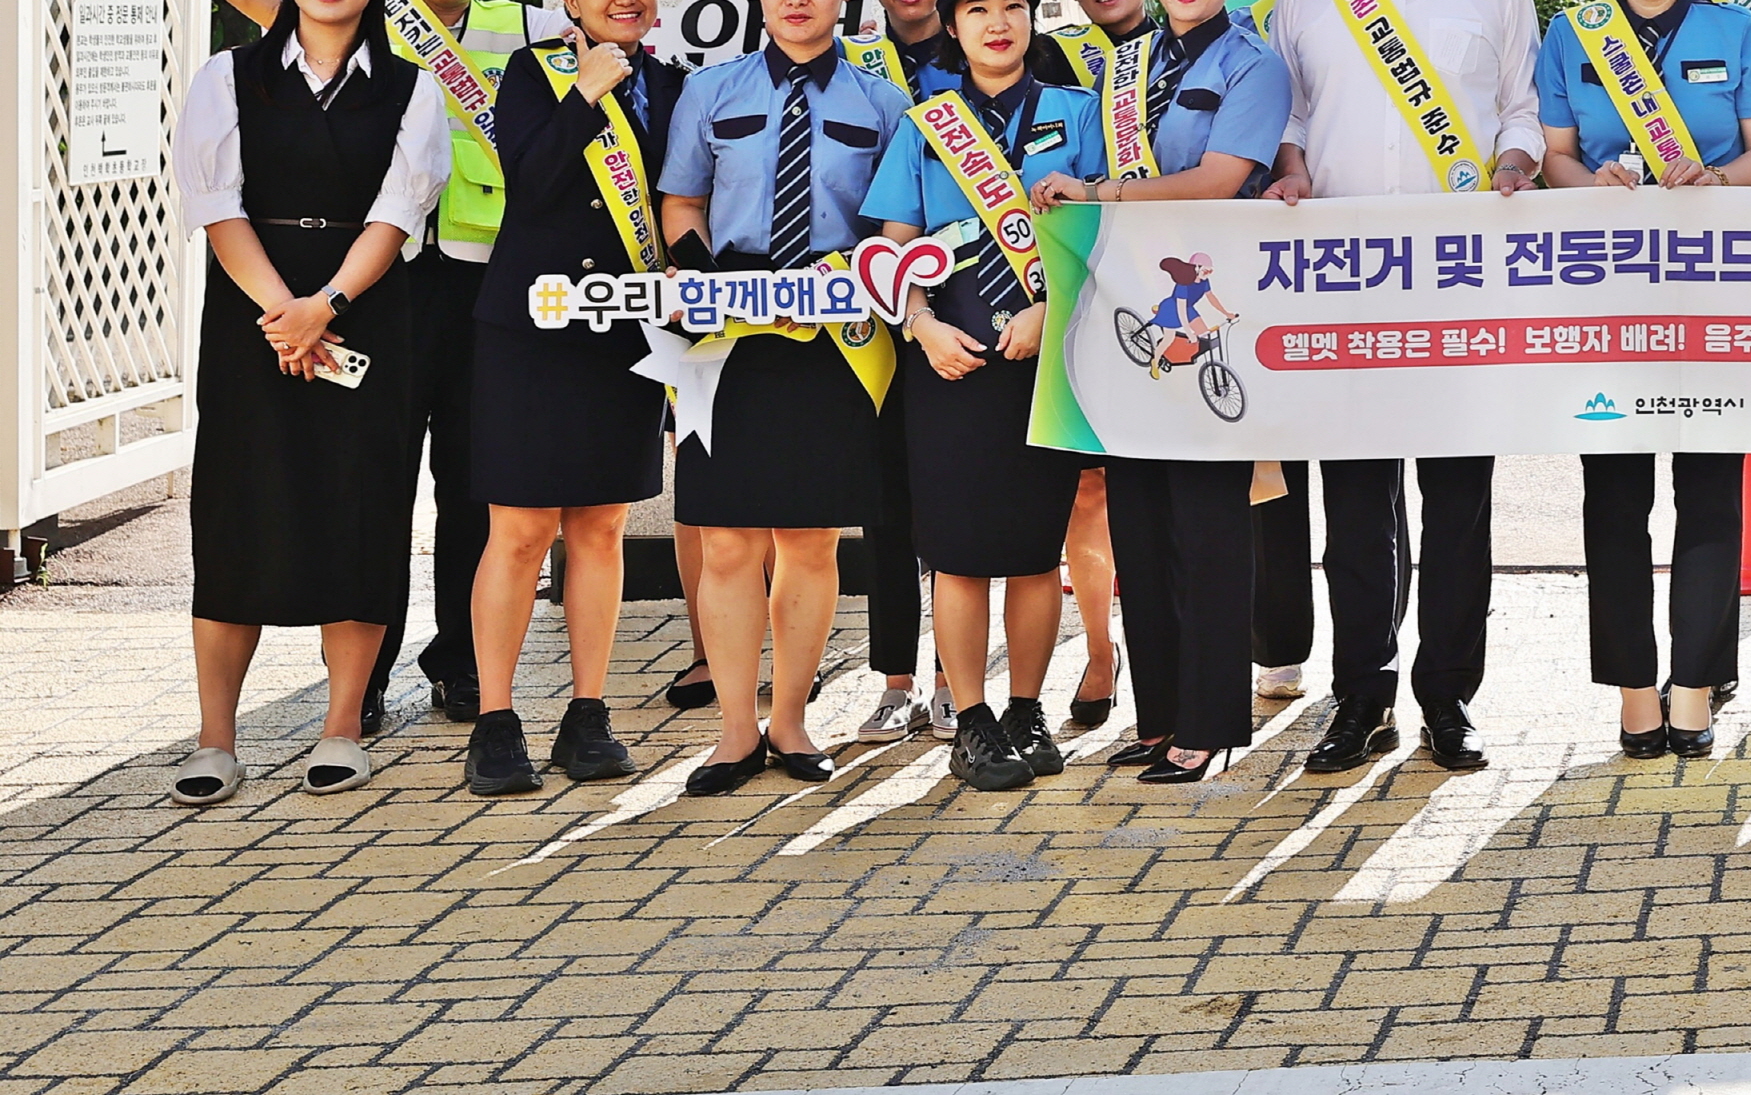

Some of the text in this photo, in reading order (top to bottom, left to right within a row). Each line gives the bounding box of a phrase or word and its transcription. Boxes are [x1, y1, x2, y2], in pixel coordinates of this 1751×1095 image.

[1364, 16, 1433, 107] 교통법규
[1420, 106, 1461, 157] 준수
[1600, 35, 1646, 96] 스쿨존
[923, 102, 1017, 211] 안전속도
[1003, 217, 1031, 245] 50
[1257, 236, 1414, 293] 자전거
[1435, 233, 1484, 288] 및
[536, 276, 862, 325] #우리 함께해요
[1282, 331, 1338, 361] 헬멧
[1347, 330, 1431, 361] 착용은
[1441, 327, 1506, 358] 필수!
[1524, 326, 1611, 356] 보행자
[1620, 324, 1686, 354] 배려!
[1635, 395, 1745, 418] 인천광역시
